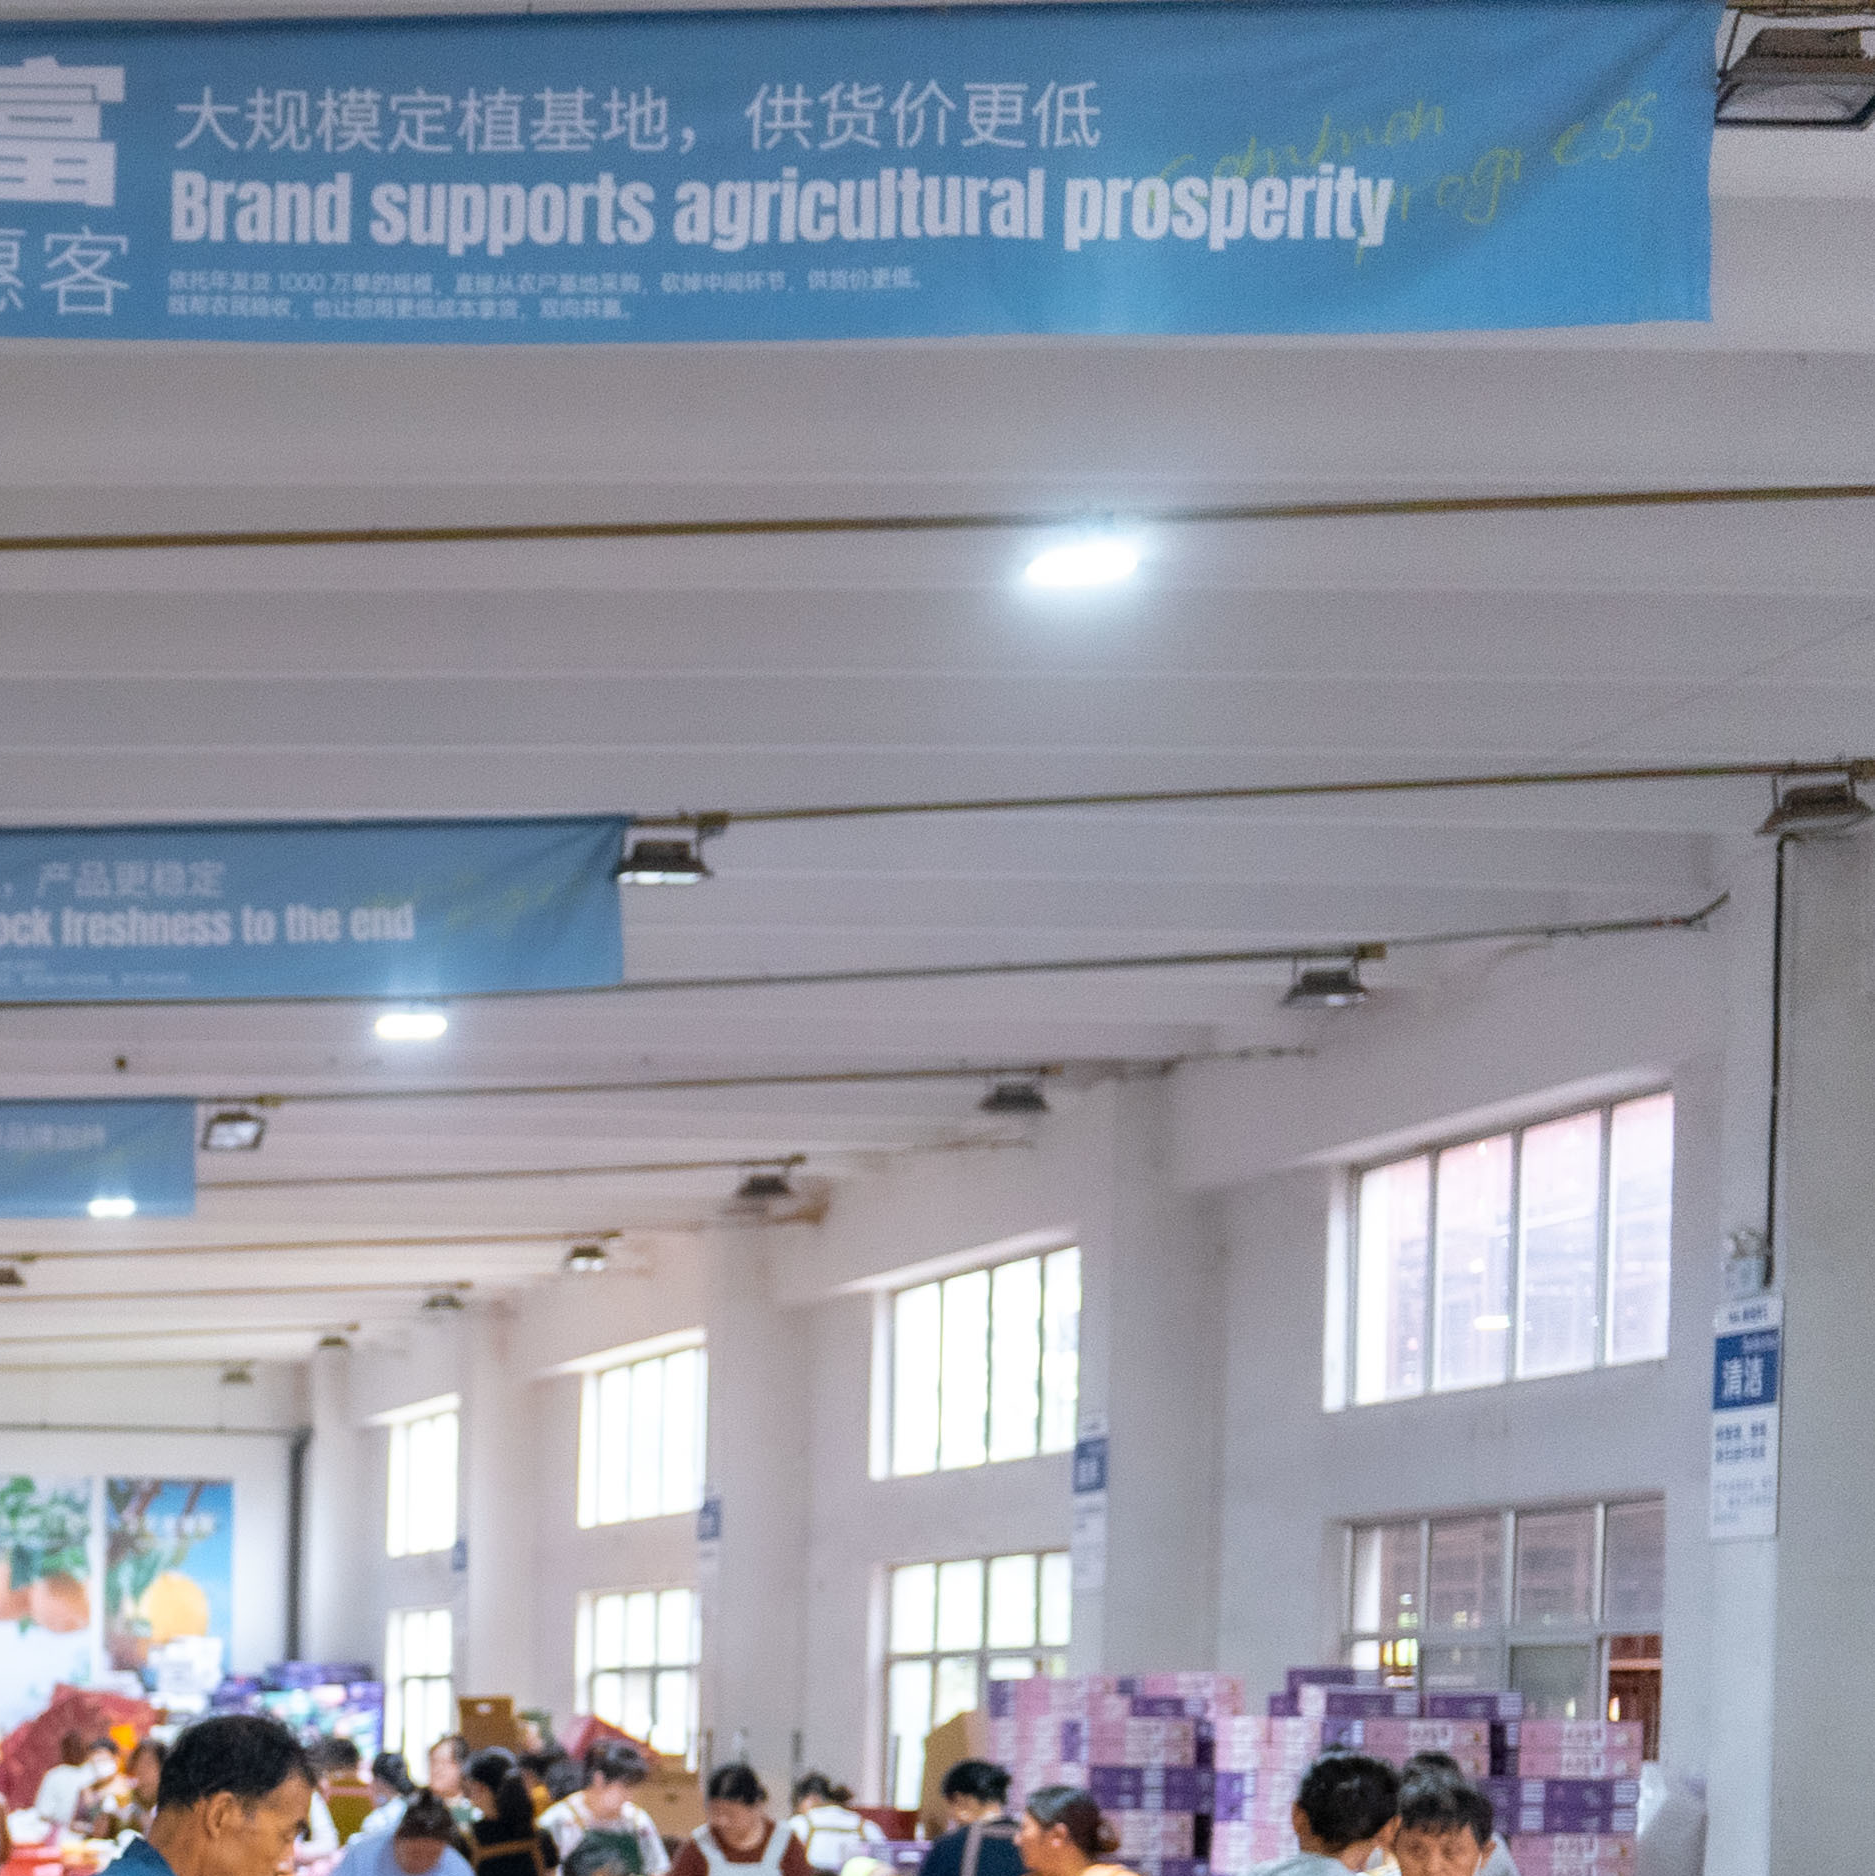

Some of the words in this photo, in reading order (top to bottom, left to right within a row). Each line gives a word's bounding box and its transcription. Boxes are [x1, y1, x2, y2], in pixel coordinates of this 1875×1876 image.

[173, 80, 1103, 154] 大规模定植基地，供货价更低
[170, 170, 354, 244] Brand
[370, 172, 655, 257] supports
[673, 164, 1045, 253] agricultural
[1063, 163, 1396, 252] prosperity
